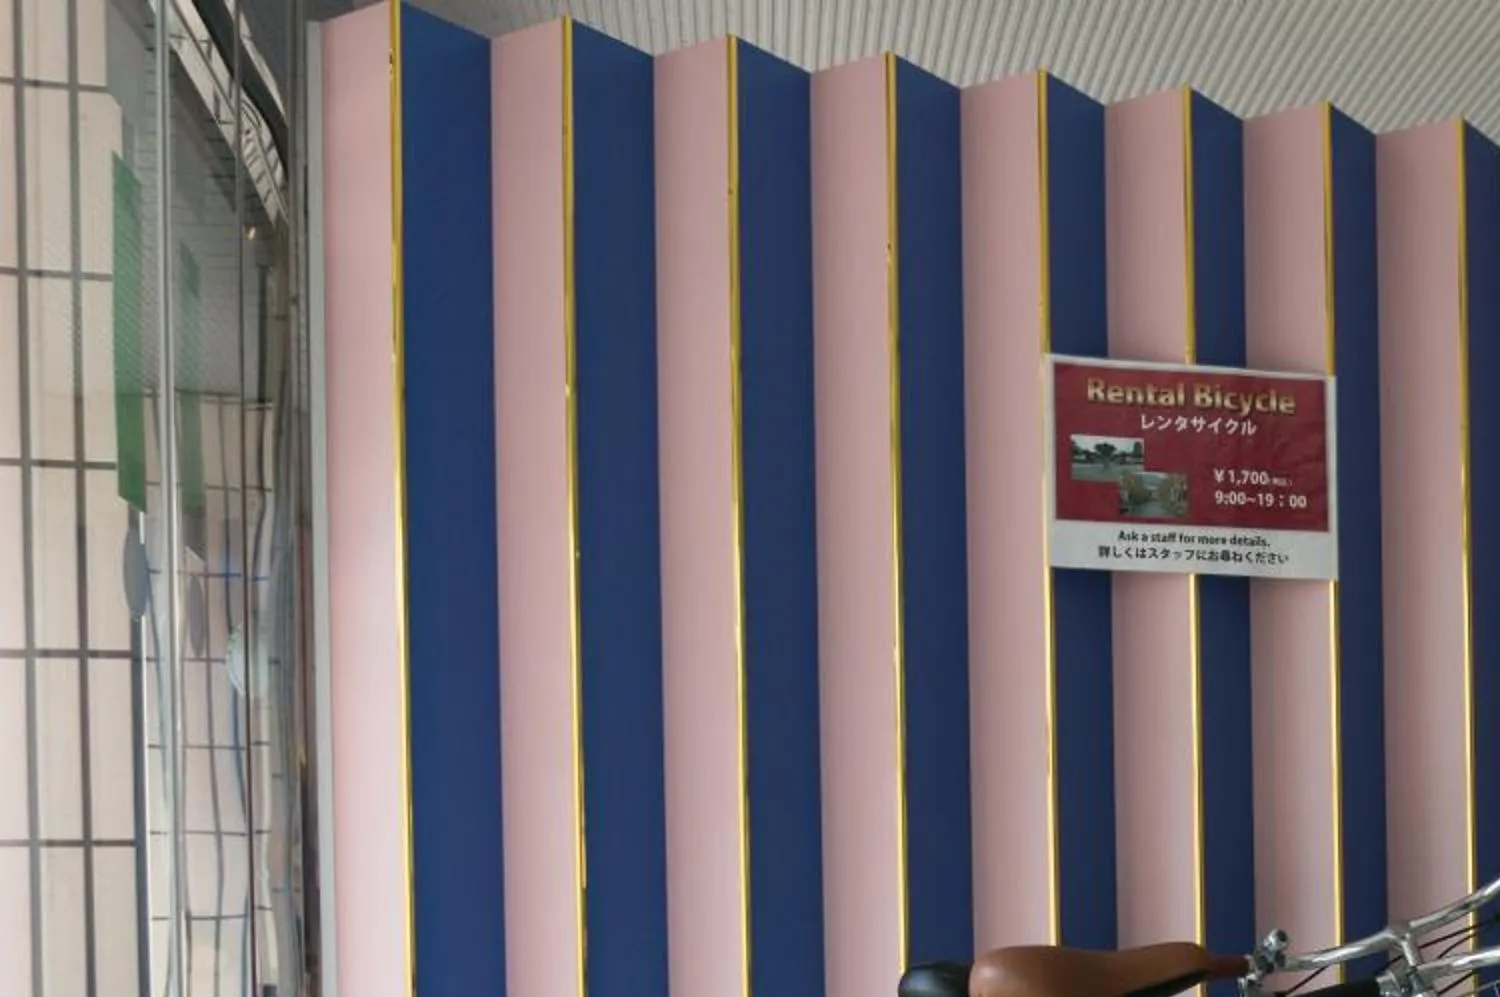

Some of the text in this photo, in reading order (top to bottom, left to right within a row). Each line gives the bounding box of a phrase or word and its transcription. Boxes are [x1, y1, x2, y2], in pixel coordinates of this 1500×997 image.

[1086, 376, 1297, 417] Rental Bicycle
[1140, 413, 1258, 437] レンタサイクル
[1117, 530, 1140, 542] Ask
[1141, 533, 1149, 543] a
[1150, 531, 1177, 543] staff
[1178, 532, 1195, 544] for
[1197, 535, 1227, 545] more
